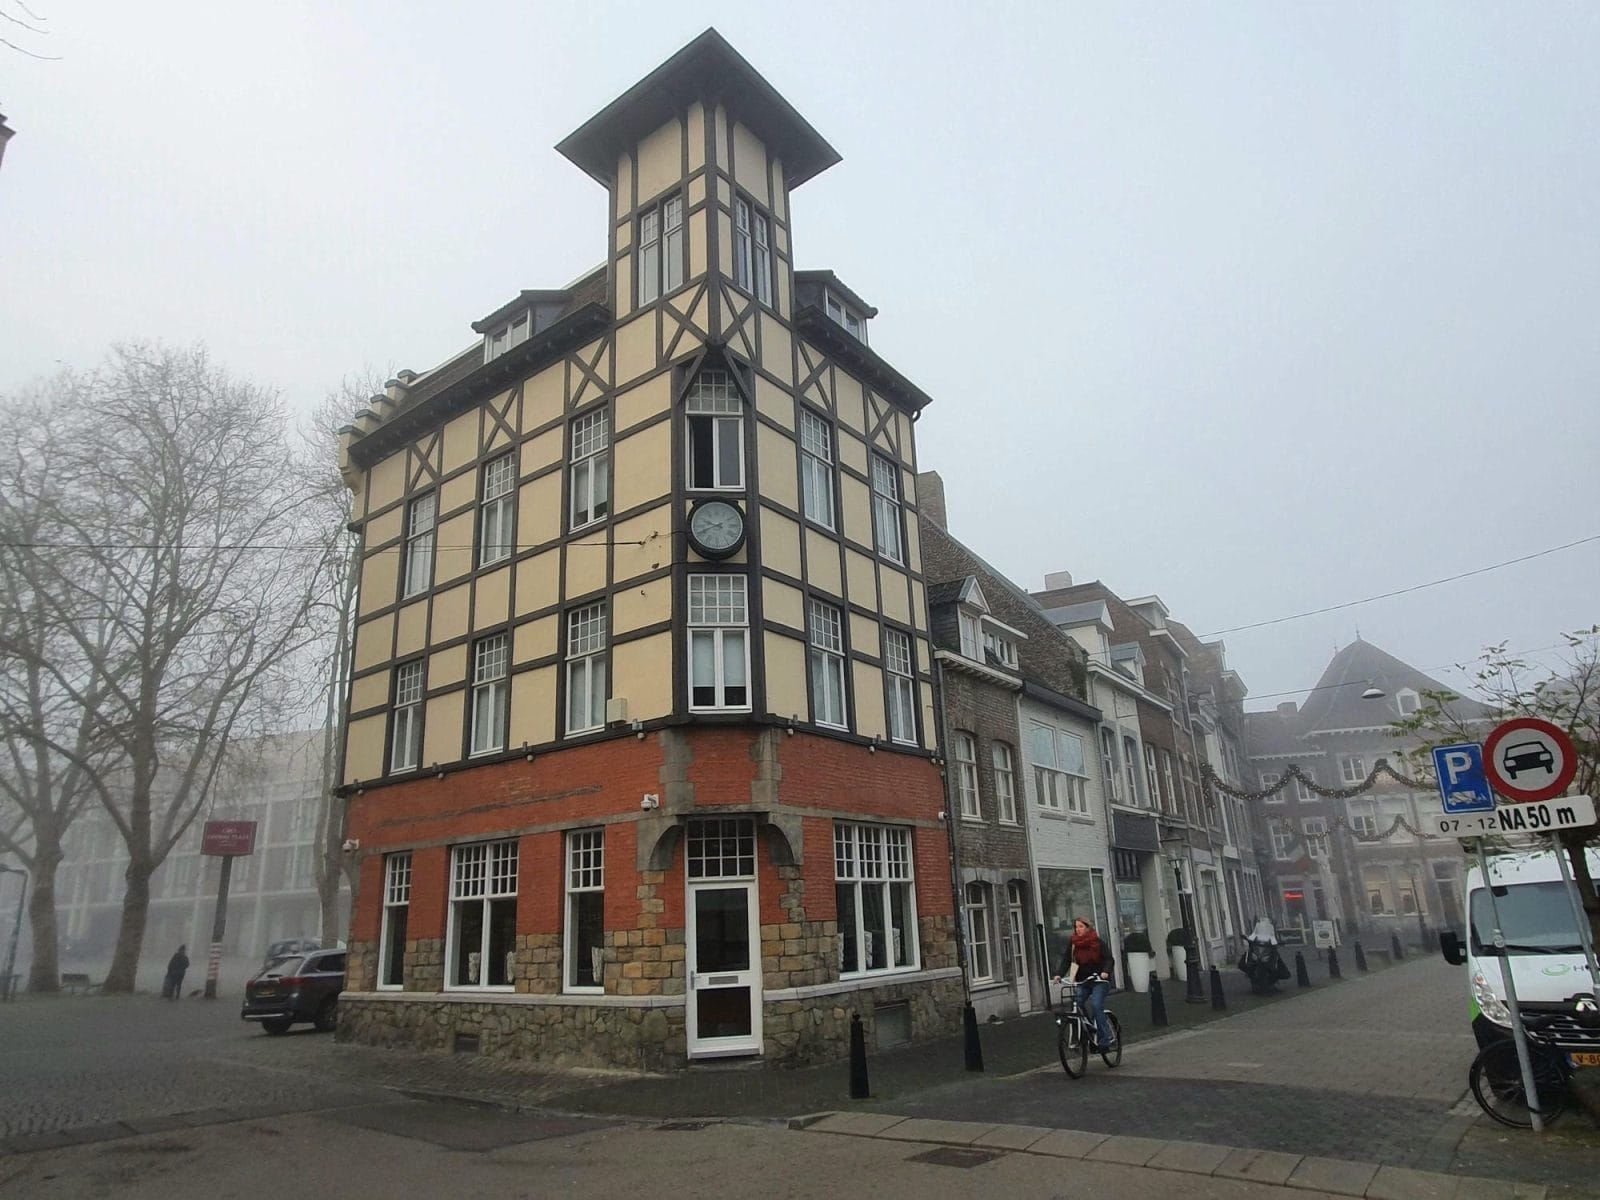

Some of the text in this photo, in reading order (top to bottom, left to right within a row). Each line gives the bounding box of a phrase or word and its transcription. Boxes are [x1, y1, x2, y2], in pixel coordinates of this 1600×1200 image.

[1445, 752, 1472, 784] P
[1440, 820, 1459, 832] 07
[1478, 817, 1496, 830] 12
[1498, 804, 1577, 831] NA 50 m
